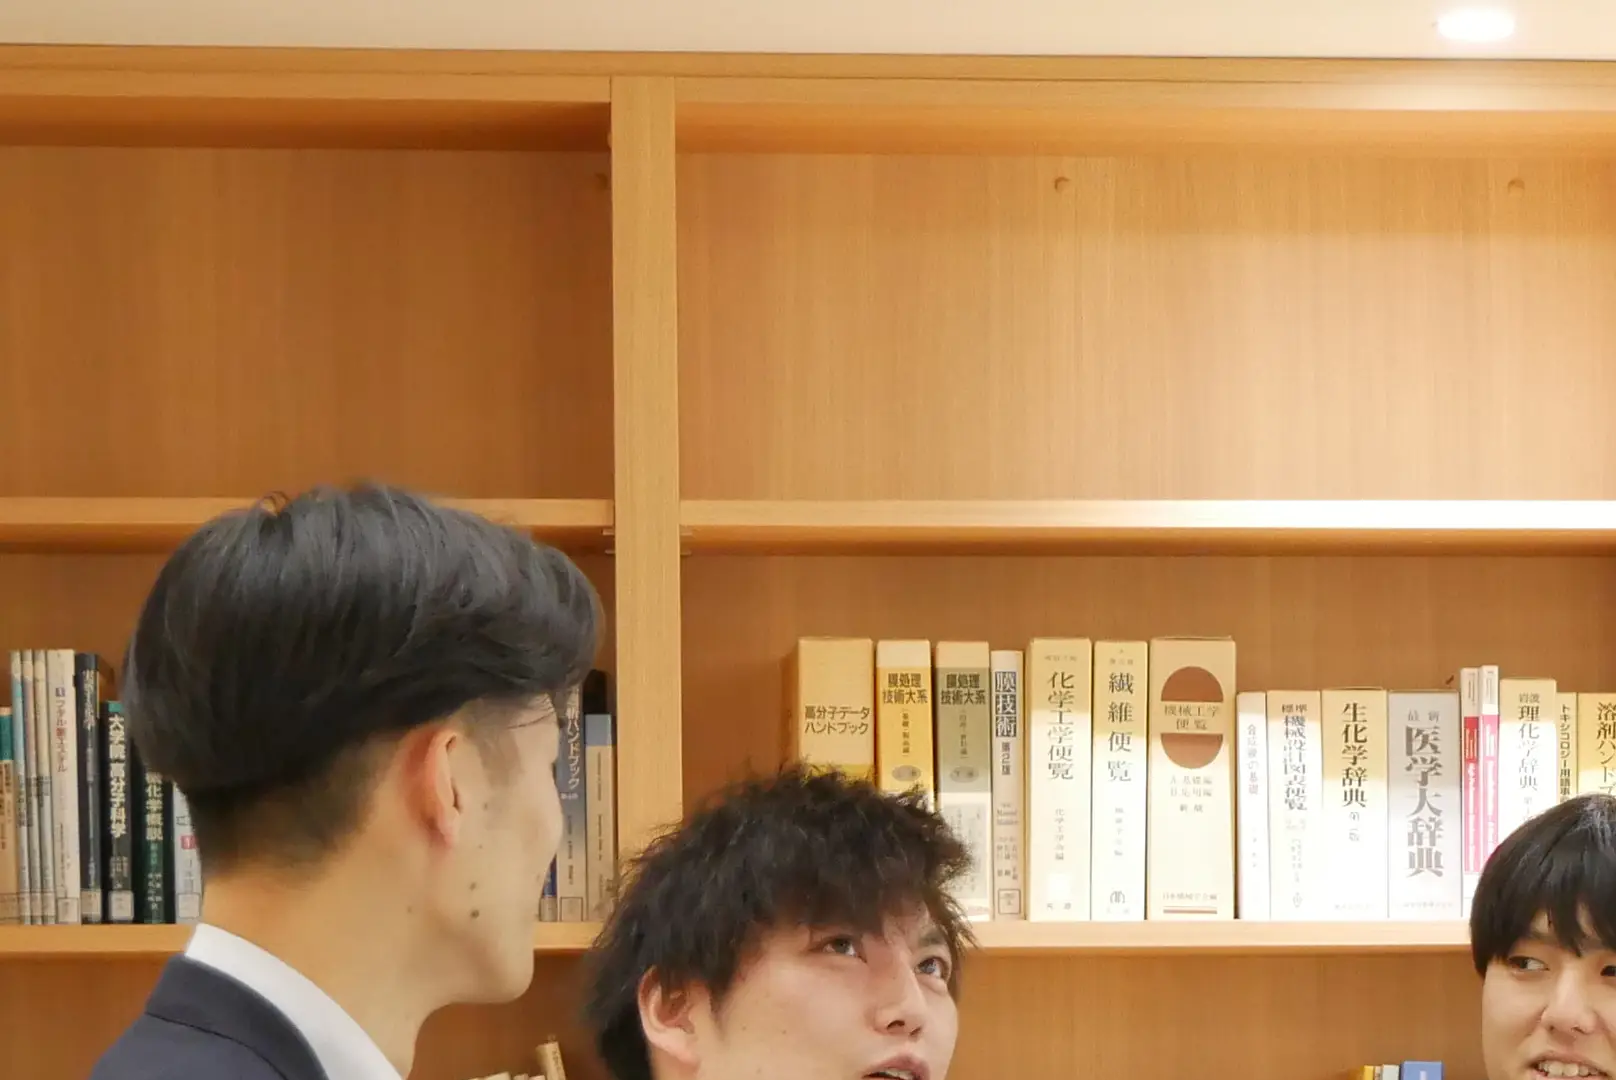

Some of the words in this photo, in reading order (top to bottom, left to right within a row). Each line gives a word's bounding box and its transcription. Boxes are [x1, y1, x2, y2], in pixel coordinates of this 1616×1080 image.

[804, 705, 870, 720] 高分子データ
[804, 721, 869, 736] ハンドブック
[1048, 671, 1075, 780] 化学工学便覧
[1108, 671, 1134, 782] 繊維便覧
[1341, 700, 1369, 808] 生化学辞典
[1518, 705, 1540, 792] 理化学辞典
[1404, 725, 1445, 878] 医学大辞典
